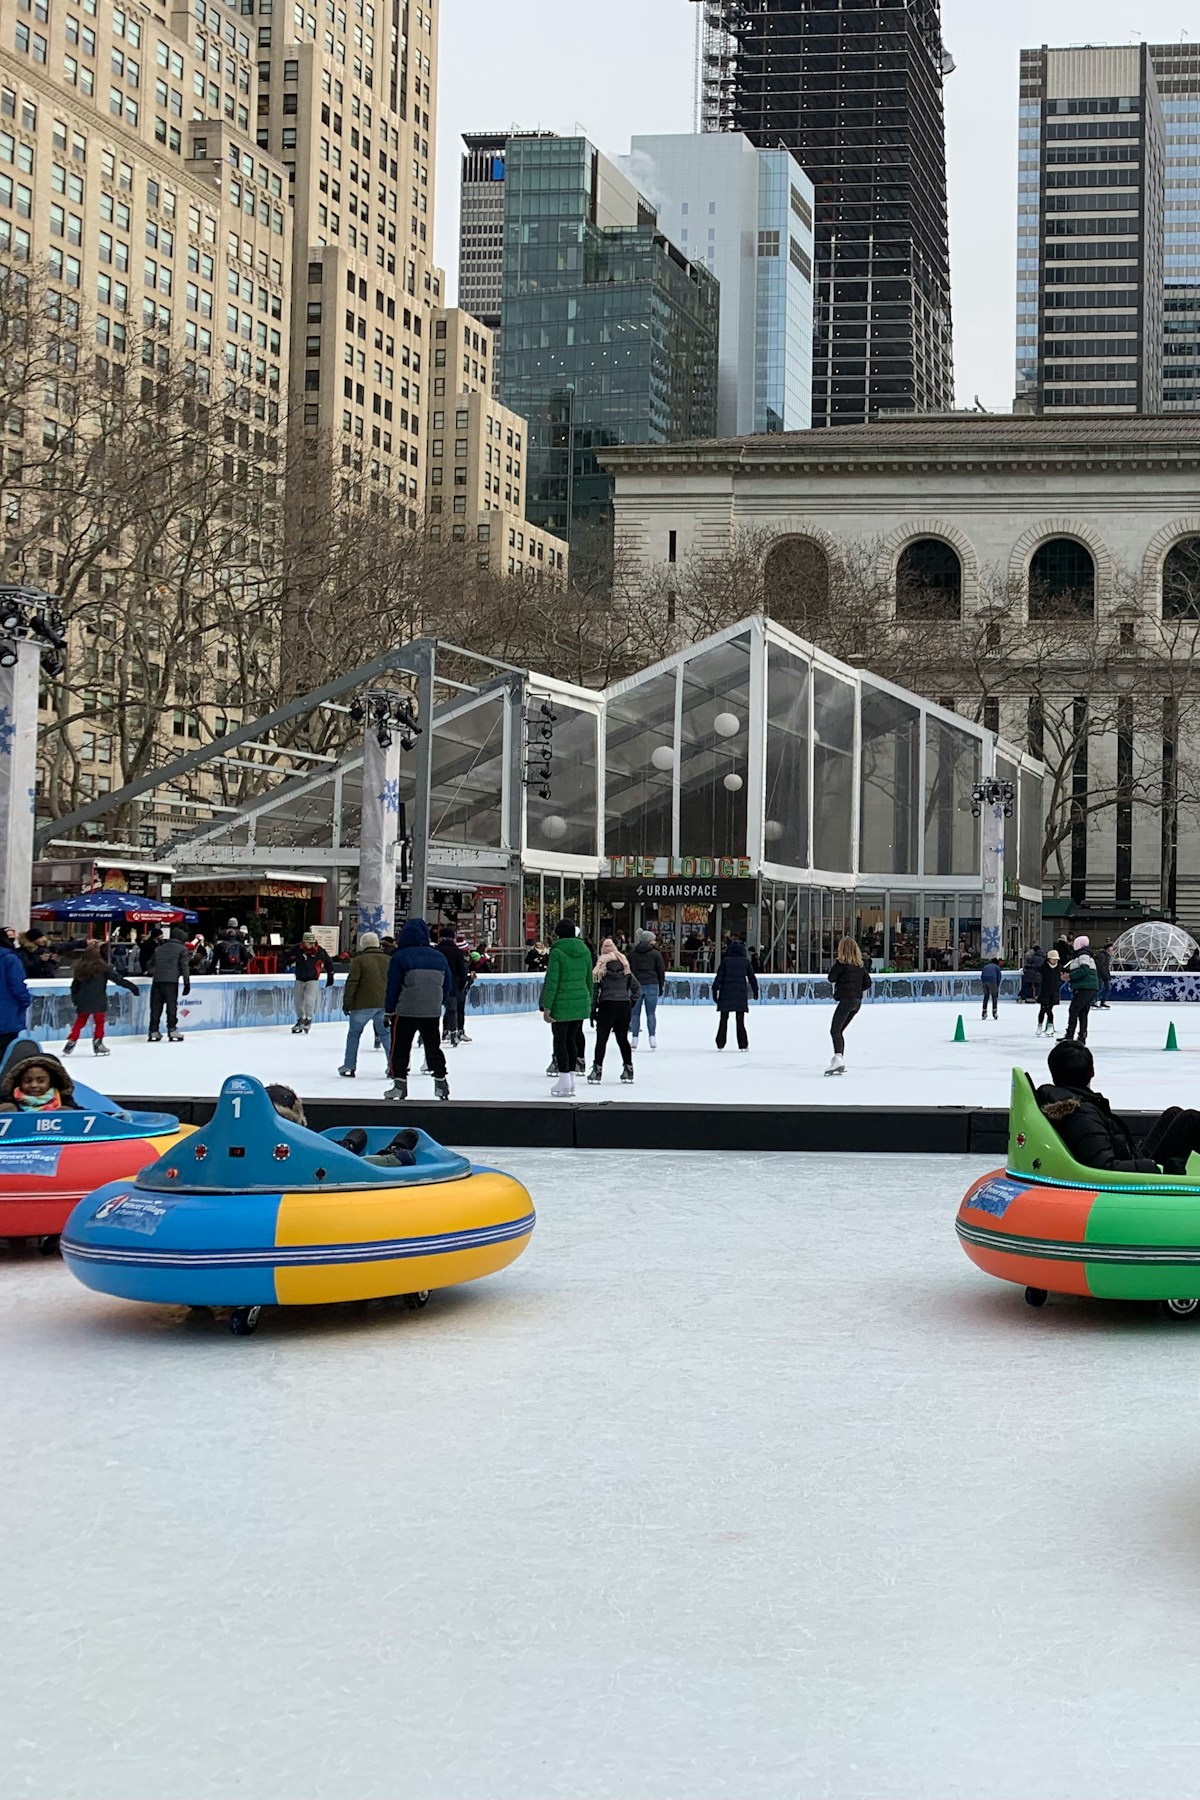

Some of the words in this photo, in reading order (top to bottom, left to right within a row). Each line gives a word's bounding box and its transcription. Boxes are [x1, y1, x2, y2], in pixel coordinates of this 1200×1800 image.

[606, 855, 656, 878] THE
[668, 855, 751, 879] LODGE
[646, 884, 718, 897] URBANSPACE
[231, 1096, 241, 1118] 1
[0, 1118, 12, 1136] 7
[36, 1118, 62, 1131] IBC
[83, 1116, 96, 1134] 7
[26, 1154, 56, 1162] Village
